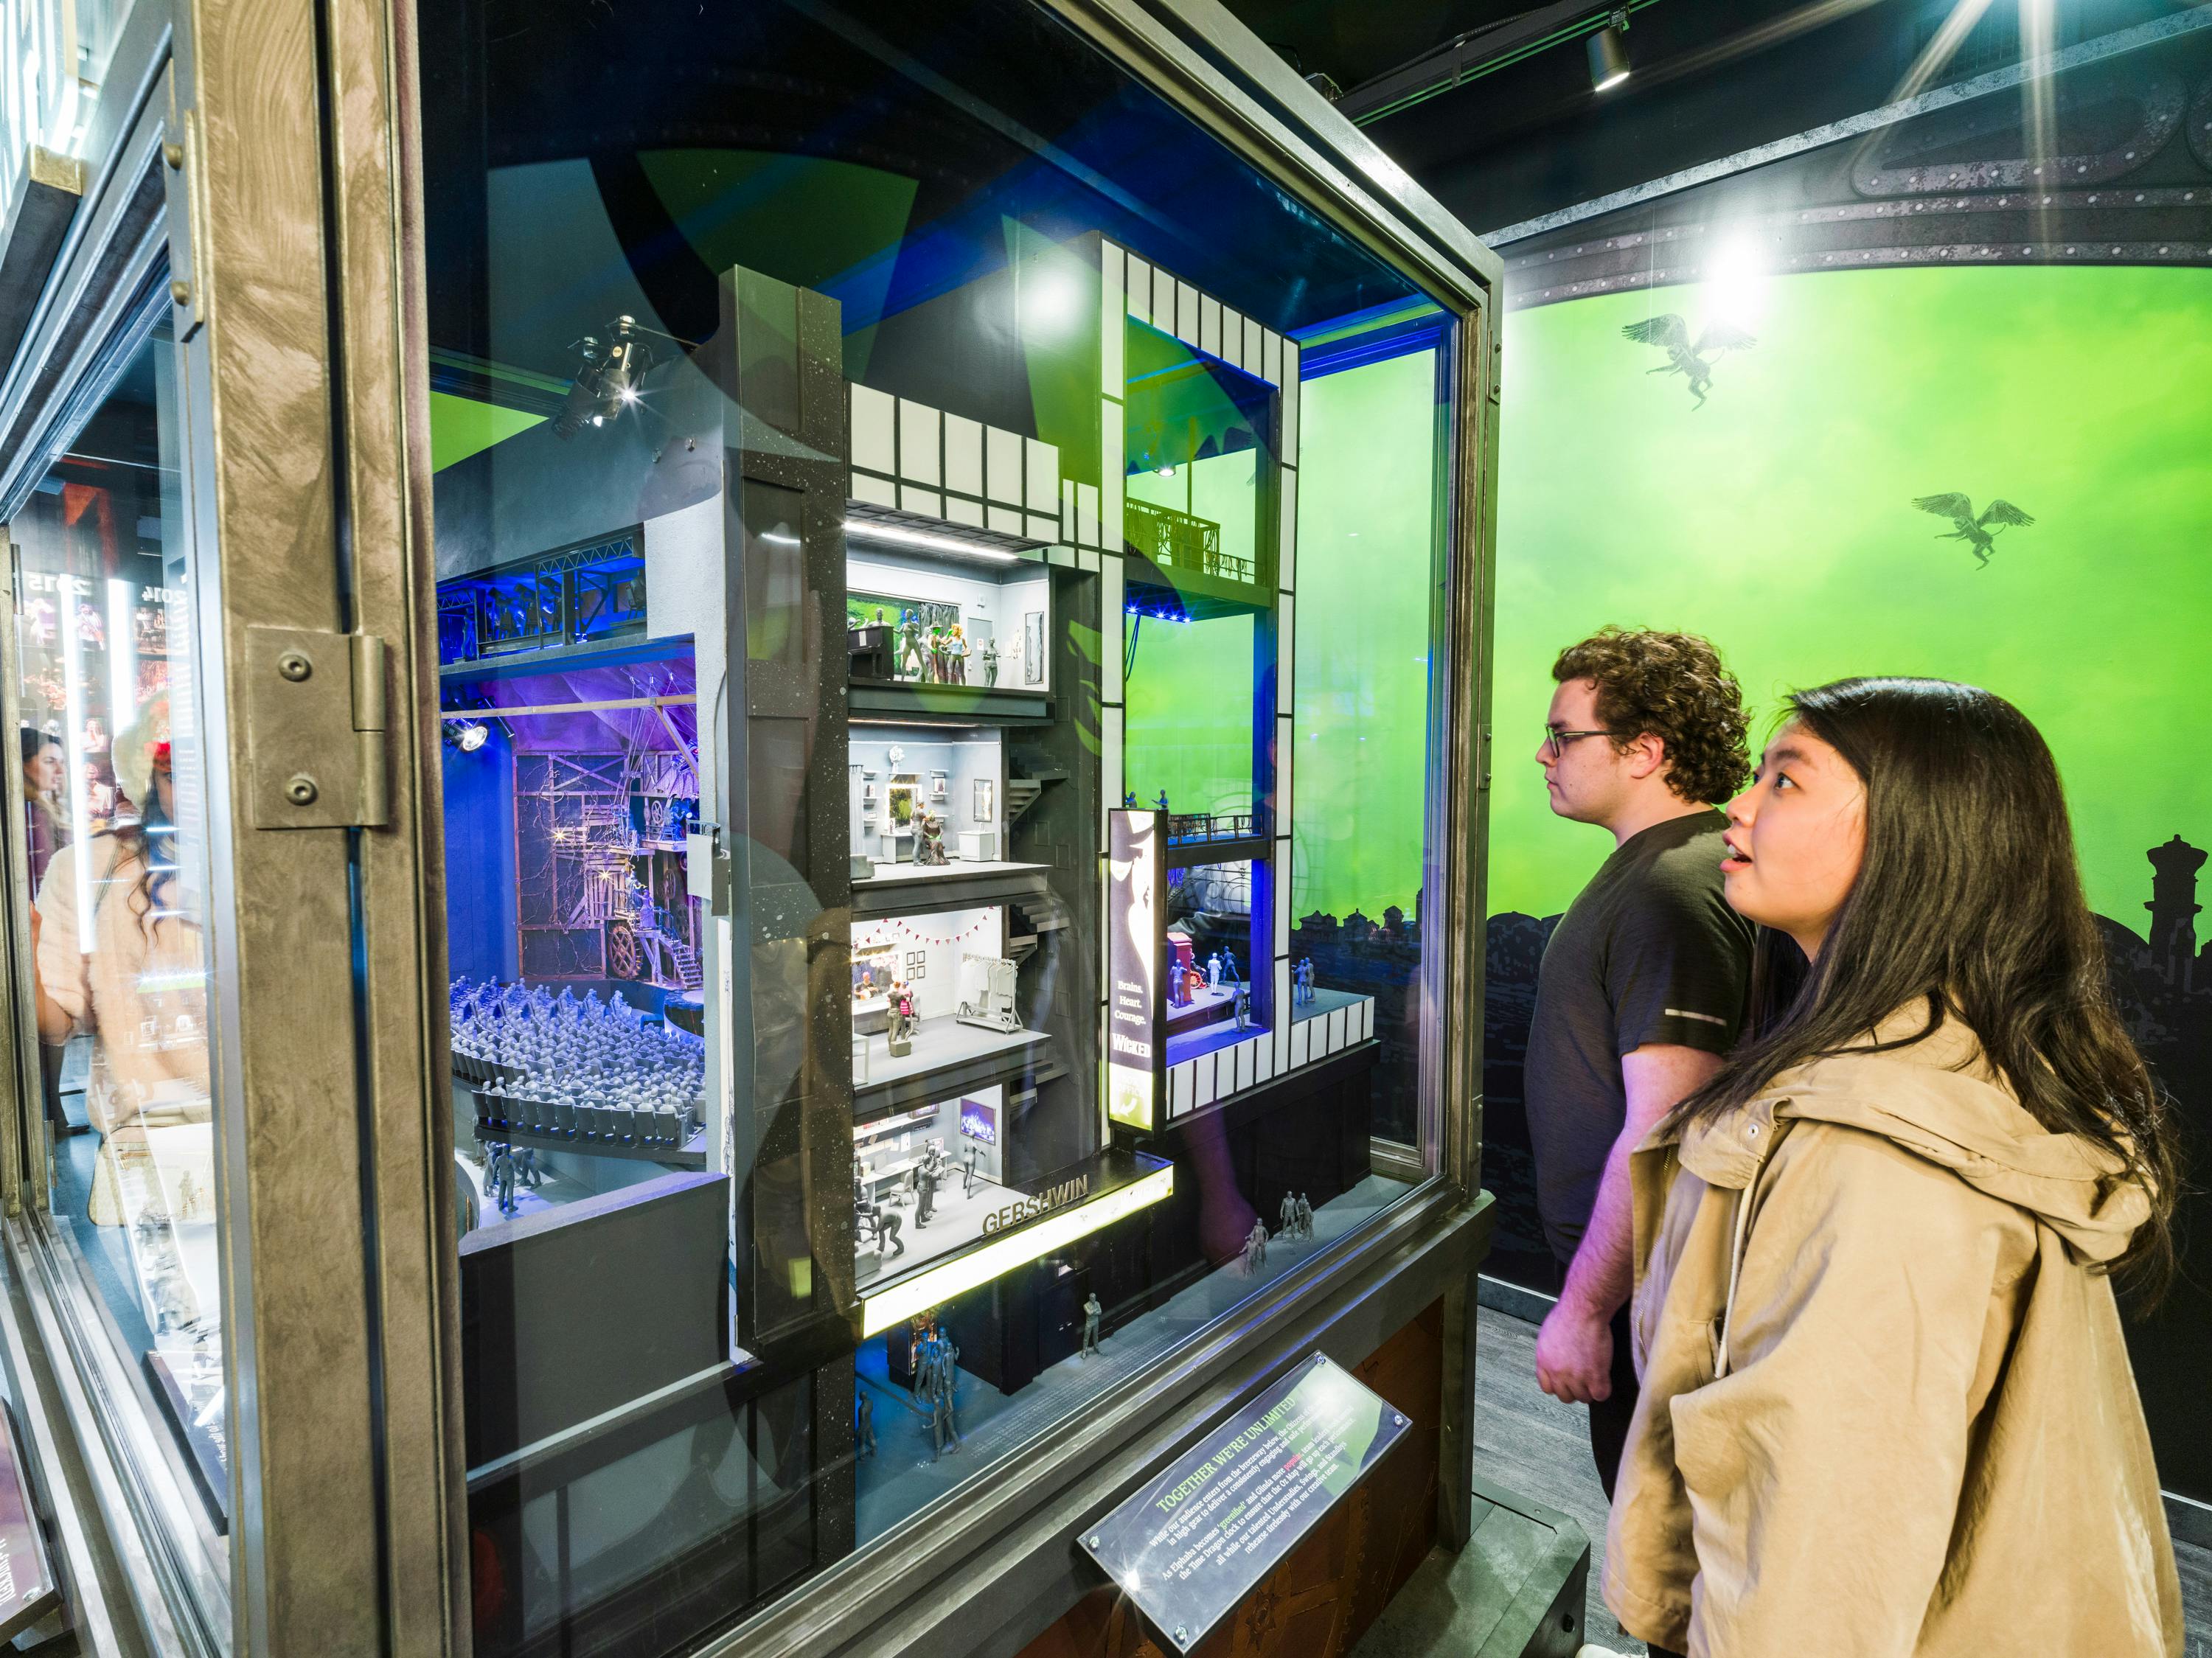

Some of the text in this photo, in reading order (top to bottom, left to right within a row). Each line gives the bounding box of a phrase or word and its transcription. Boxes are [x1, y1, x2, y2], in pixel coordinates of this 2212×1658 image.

[1114, 1009, 1147, 1025] Courage.
[1117, 980, 1144, 994] Brains.
[1119, 995, 1142, 1009] Heart.
[1112, 1033, 1151, 1058] WICKED
[982, 1174, 1088, 1235] GERSHWIN
[1149, 1528, 1169, 1547] While
[1164, 1519, 1180, 1533] our
[1178, 1500, 1204, 1523] audience
[1203, 1486, 1220, 1502] enters
[1217, 1475, 1233, 1488] from
[1230, 1468, 1242, 1478] the
[1238, 1447, 1266, 1470] breezeway
[1262, 1435, 1281, 1449] below,
[1277, 1428, 1288, 1437] the
[1285, 1414, 1305, 1430] Citizens
[1155, 1396, 1295, 1511] TOGETHER WE'RE UNLIMITED
[1166, 1537, 1177, 1546] in
[1173, 1525, 1190, 1540] high
[1189, 1514, 1203, 1530] gear
[1200, 1509, 1209, 1517] to
[1207, 1493, 1227, 1511] deliver
[1230, 1464, 1260, 1491] consistently
[1259, 1446, 1283, 1466] engaging
[1279, 1438, 1290, 1449] and
[1288, 1430, 1300, 1441] safe
[1215, 1441, 1347, 1566] all while our talented Understudies, Swings, and Standbys
[1161, 1569, 1173, 1581] As
[1169, 1548, 1196, 1572] Elphaba
[1192, 1527, 1220, 1550] becomes
[1217, 1501, 1246, 1530] 'greenified'
[1245, 1491, 1258, 1505] and
[1255, 1479, 1273, 1495] Glinda
[1271, 1467, 1285, 1481] more
[1283, 1452, 1304, 1471] popular,
[1301, 1441, 1315, 1454] team
[1178, 1568, 1192, 1580] the
[1188, 1555, 1206, 1570] Time
[1203, 1536, 1226, 1558] Dragon
[1224, 1523, 1240, 1539] clock
[1237, 1518, 1246, 1526] to
[1244, 1502, 1263, 1520] ensure
[1260, 1492, 1273, 1505] that
[1270, 1485, 1281, 1495] the
[1279, 1478, 1289, 1487] Oz
[1285, 1469, 1300, 1481] Map
[1296, 1460, 1308, 1471] will
[1305, 1455, 1313, 1465] go
[1311, 1449, 1321, 1457] up
[1318, 1441, 1330, 1452] each
[1245, 1463, 1340, 1554] rehearse tirelessly with our creative team.
